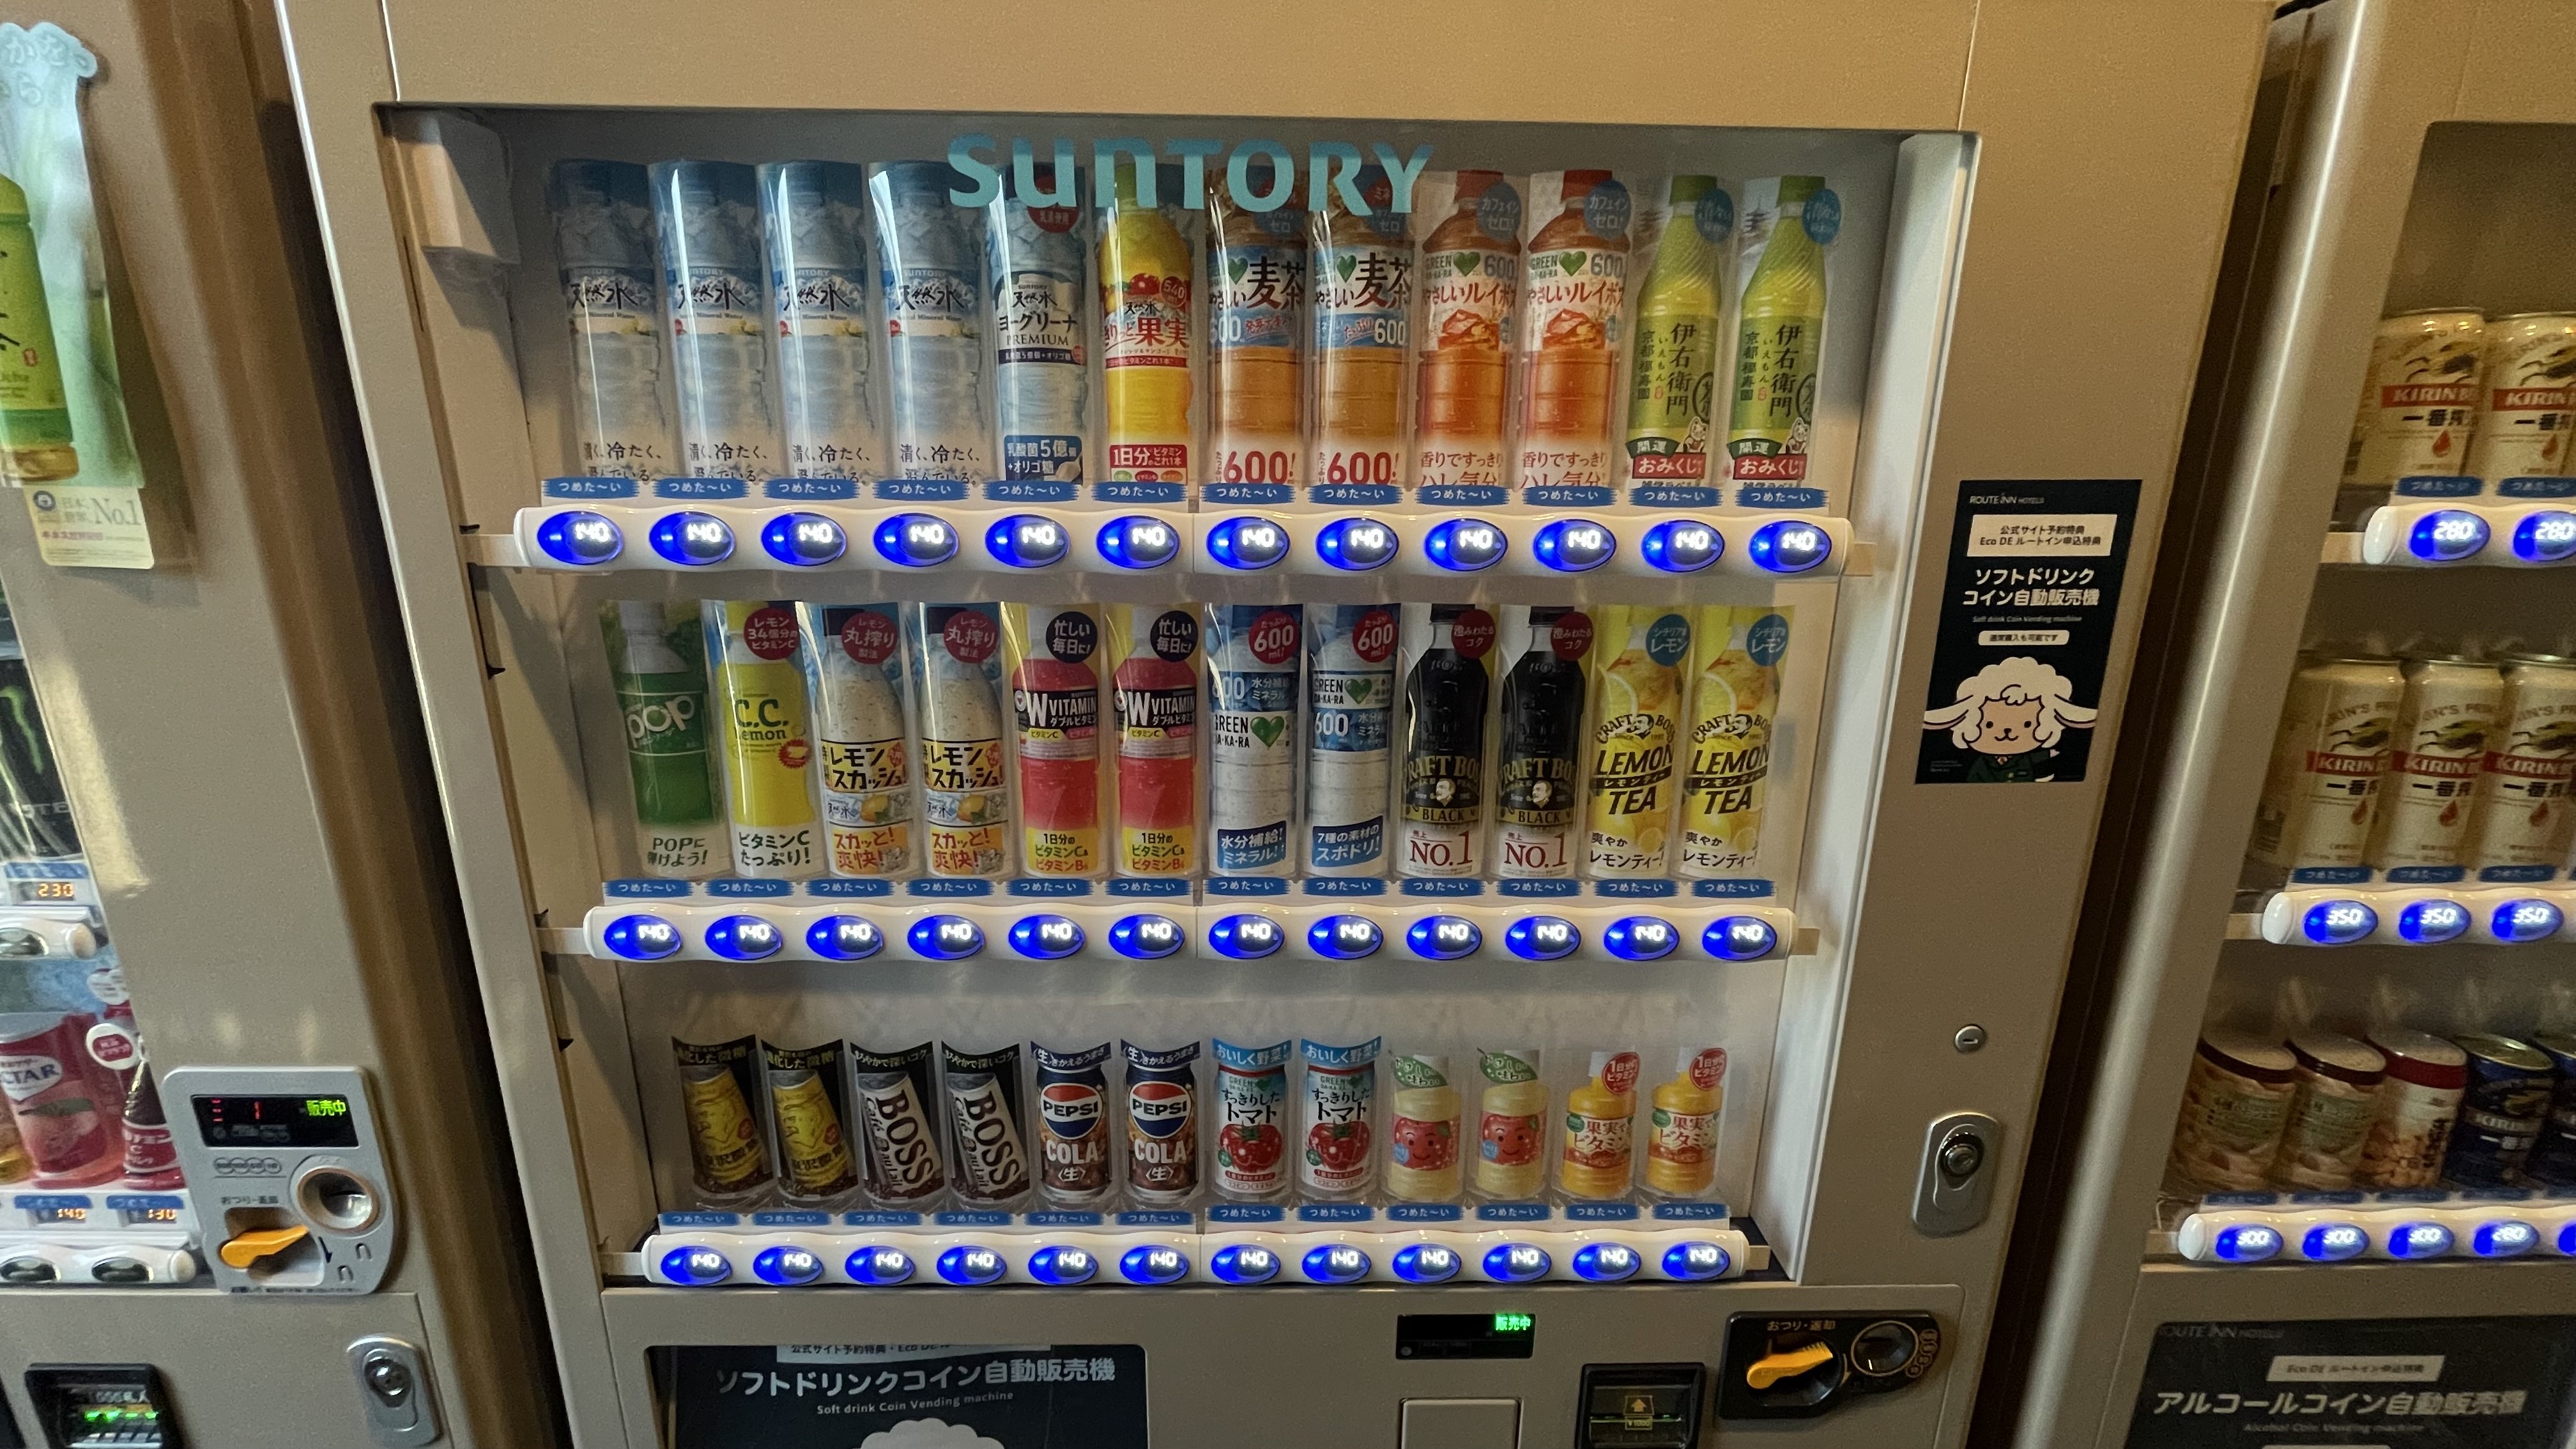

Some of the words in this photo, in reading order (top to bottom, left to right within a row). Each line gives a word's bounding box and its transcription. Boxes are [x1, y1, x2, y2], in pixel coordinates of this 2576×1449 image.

[1529, 255, 1558, 269] GREEN
[1163, 280, 1186, 299] 540
[1007, 333, 1069, 346] PREMIUM
[1666, 323, 1697, 416] 伊右衛門
[1770, 324, 1803, 418] 伊右衛門
[2393, 387, 2456, 402] KIRIN
[2505, 392, 2566, 406] KIRIN
[576, 523, 611, 542] 140
[687, 523, 721, 542] 140
[799, 523, 832, 542] 140
[910, 525, 944, 544] 140
[1133, 526, 1165, 546] 140
[1243, 528, 1274, 547] 140
[2435, 521, 2474, 539] 280
[1460, 530, 1492, 549] 140
[1568, 530, 1600, 549] 140
[1782, 532, 1815, 551] 140
[1980, 537, 1997, 546] Eco
[1999, 537, 2013, 546] DE
[1975, 567, 2095, 585] ソフトドリンク
[1963, 588, 2100, 606] コイン自動販売機
[753, 617, 790, 628] レモン
[1054, 620, 1091, 636] 忙しい
[1159, 620, 1192, 636] 忙しい
[1253, 627, 1295, 653] 600
[1357, 627, 1394, 652] 600
[1465, 638, 1485, 648] コク
[1314, 678, 1344, 693] GREEN
[733, 698, 790, 729] C.C.
[1026, 693, 1048, 727] W
[1049, 696, 1097, 716] VITAMIN
[1127, 691, 1151, 726] W
[1151, 695, 1195, 716] VITAMIN
[1315, 712, 1349, 737] 600
[1596, 714, 1634, 744] CRAFT
[831, 746, 885, 767] レモン
[1597, 746, 1676, 776] LEMON
[1692, 746, 1770, 776] LEMON
[2406, 758, 2466, 774] KIRIN
[1608, 788, 1657, 816] TEA
[1704, 788, 1754, 815] TEA
[1422, 808, 1465, 822] BLACK
[1518, 810, 1561, 824] BLACK
[738, 830, 811, 850] ビタミンC
[1409, 830, 1473, 867] NO.1
[739, 848, 812, 867] たっぷり!
[1504, 832, 1568, 868] NO.1
[38, 883, 74, 898] 230
[2327, 909, 2362, 924] 350
[2421, 908, 2456, 923] 350
[2514, 908, 2549, 923] 350
[639, 924, 670, 940] 140
[841, 924, 871, 940] 140
[1043, 923, 1071, 939] 140
[1142, 923, 1171, 939] 140
[1340, 924, 1369, 939] 140
[1538, 924, 1567, 940] 140
[1733, 924, 1763, 940] 140
[306, 1099, 347, 1117] 販売中
[1043, 1099, 1099, 1117] PEPSI
[1132, 1098, 1188, 1116] PEPSI
[1227, 1101, 1277, 1124] トマト
[1317, 1101, 1367, 1122] トマト
[875, 1088, 934, 1184] BOSS
[963, 1090, 1020, 1185] BOSS
[1045, 1139, 1100, 1165] COLA
[1133, 1138, 1188, 1164] COLA
[693, 1254, 719, 1267] 140
[877, 1254, 903, 1267] 140
[968, 1254, 993, 1266] 140
[1151, 1252, 1176, 1266] 140
[1332, 1251, 1358, 1266] 140
[1512, 1250, 1538, 1264] 140
[1690, 1248, 1717, 1262] 140
[1495, 1315, 1531, 1331] 販売中
[716, 1358, 1117, 1398] ソフトドリンクコイン自動販売機
[817, 1404, 841, 1415] Soft
[844, 1403, 877, 1414] drink
[879, 1401, 907, 1411] Coin
[910, 1397, 961, 1409] Vending
[964, 1390, 1015, 1404] machine
